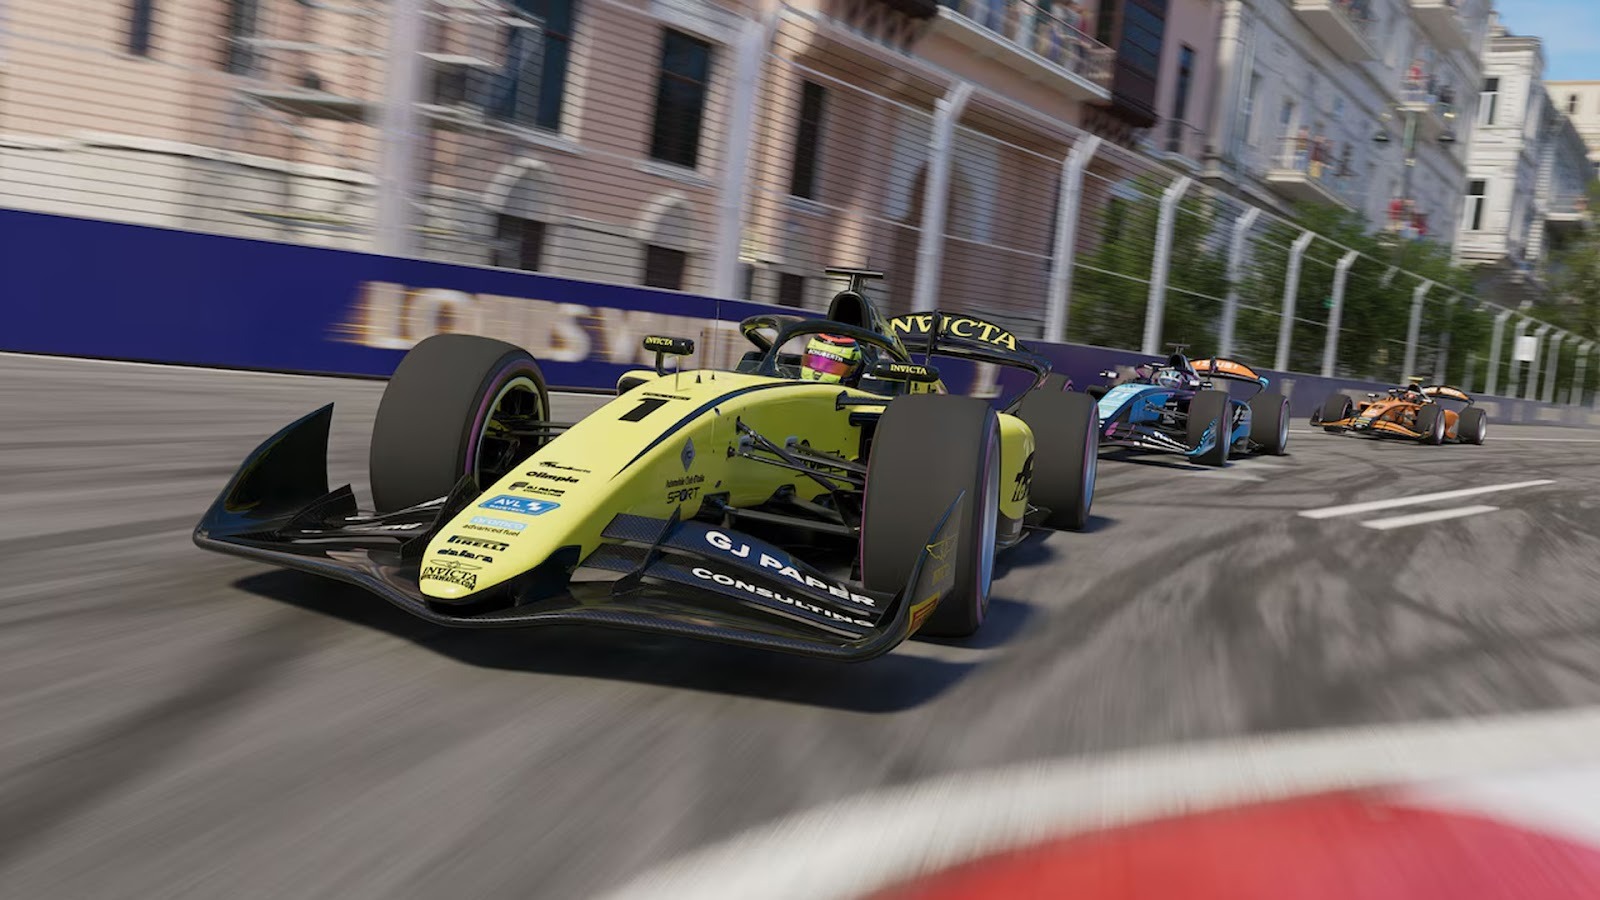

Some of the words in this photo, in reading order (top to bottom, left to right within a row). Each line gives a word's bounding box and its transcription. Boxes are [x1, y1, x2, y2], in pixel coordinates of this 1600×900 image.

[356, 280, 591, 362] LOS
[645, 336, 673, 346] INVICTA
[889, 316, 1017, 351] NVICTA
[890, 364, 927, 375] INVICTA
[618, 397, 670, 422] 1
[526, 471, 580, 483] Olimpia
[494, 498, 521, 508] AVL
[667, 487, 700, 504] SPORT
[463, 524, 502, 534] advanced
[503, 529, 520, 537] fuel
[447, 535, 510, 551] PIRELLI
[422, 566, 477, 584] INVICTA
[705, 530, 750, 558] GJ
[760, 553, 876, 607] PAPER
[691, 567, 875, 628] CONSULTING
